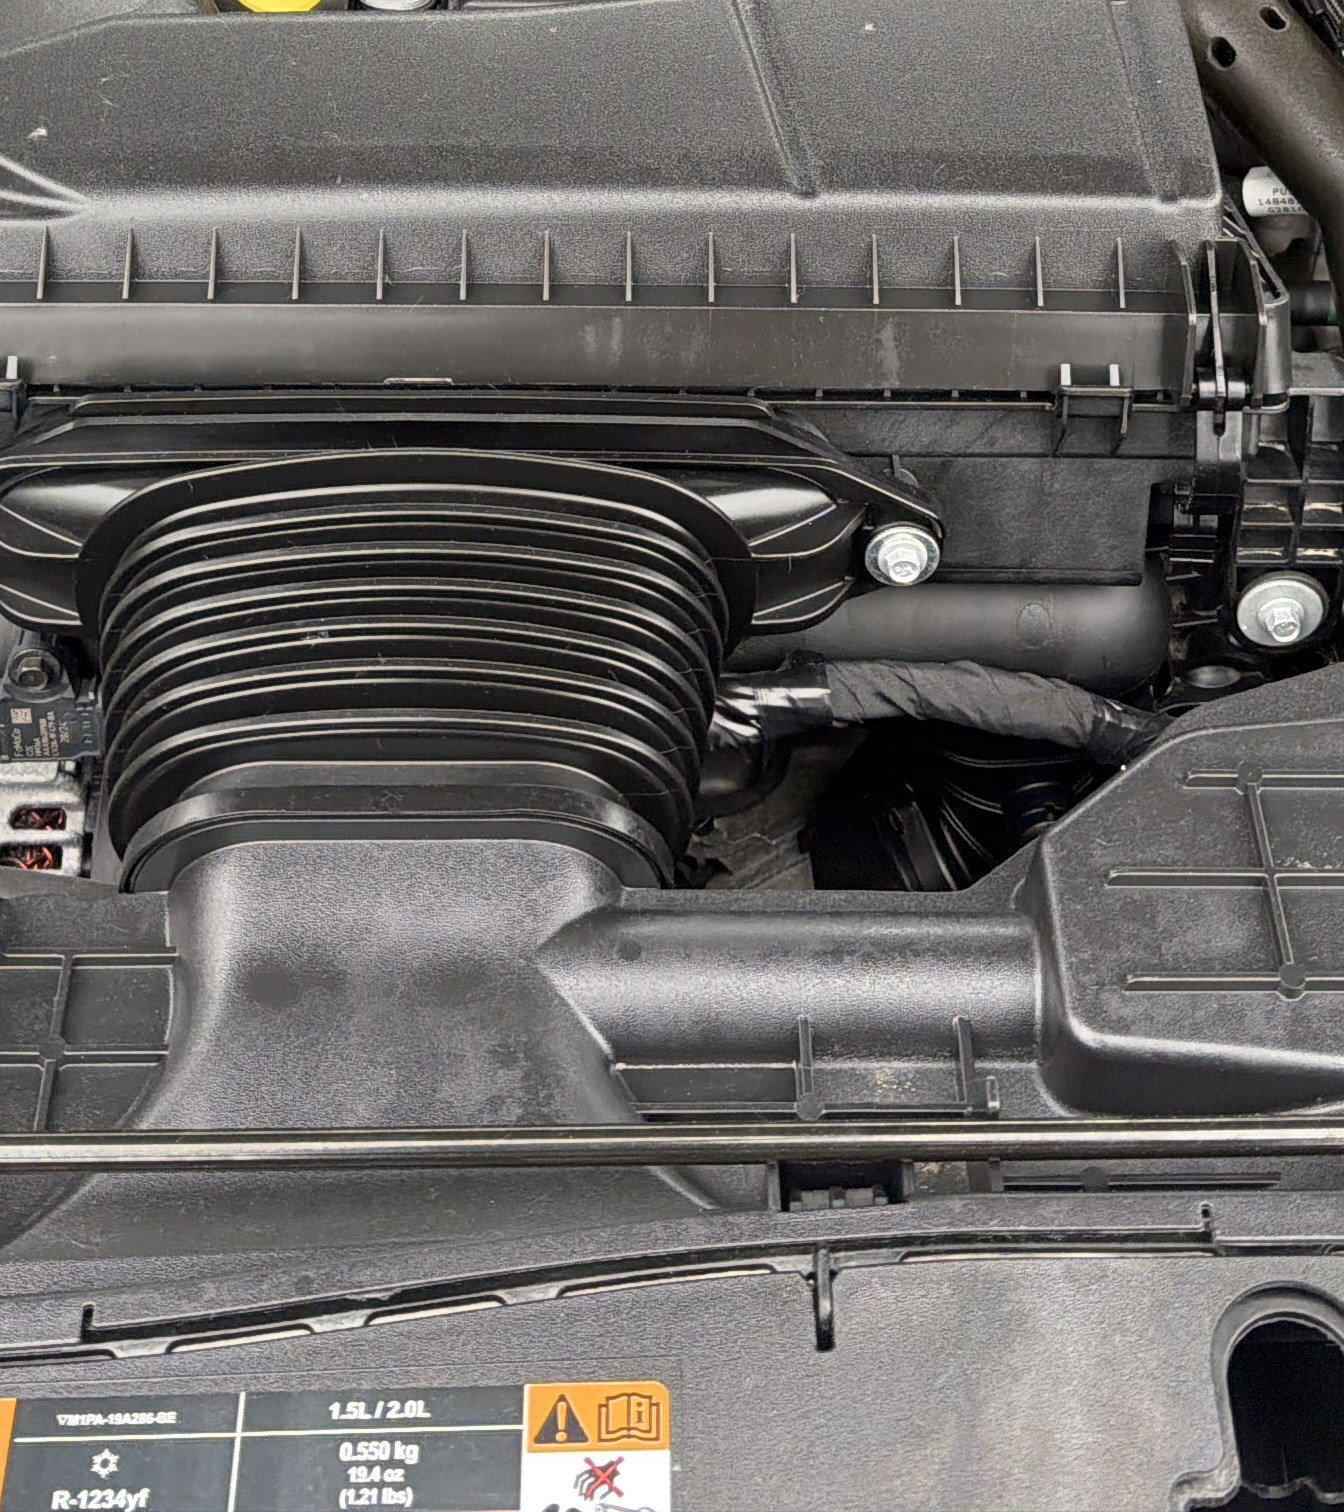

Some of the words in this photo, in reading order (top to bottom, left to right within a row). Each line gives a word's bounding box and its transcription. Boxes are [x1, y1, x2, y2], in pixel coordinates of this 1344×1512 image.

[328, 1401, 372, 1420] 1.5L
[374, 1400, 385, 1419] /
[386, 1399, 432, 1419] 2.0L
[339, 1440, 391, 1462] 0.550
[393, 1440, 420, 1464] kg
[347, 1465, 381, 1483] 19.4
[383, 1468, 405, 1482] oz
[51, 1487, 150, 1512] R-1234yf
[339, 1487, 378, 1509] (1.21
[380, 1486, 413, 1508] lbs)
